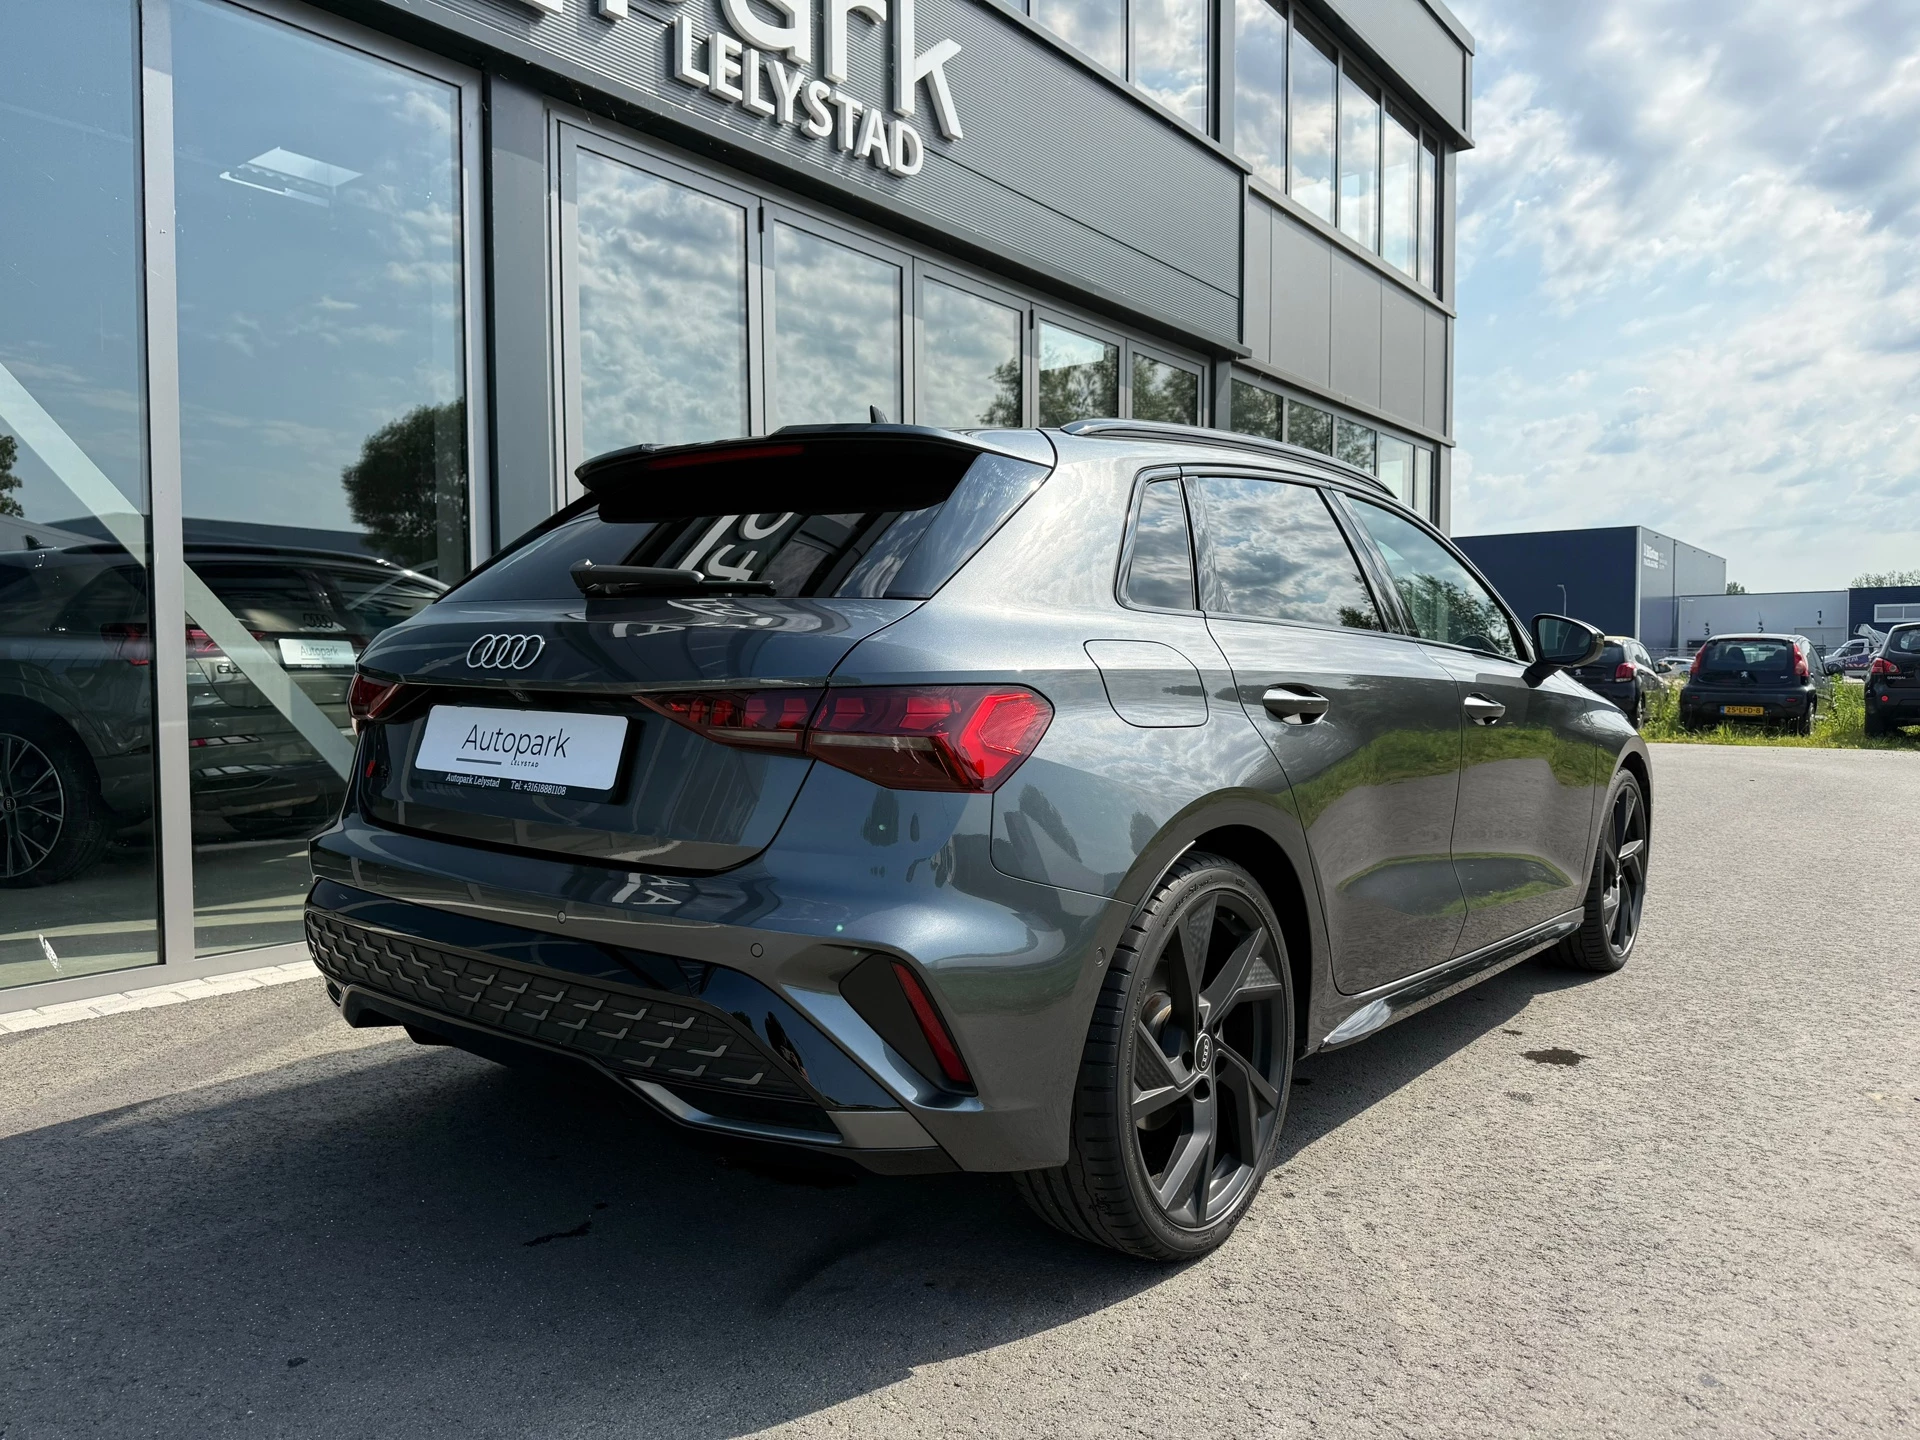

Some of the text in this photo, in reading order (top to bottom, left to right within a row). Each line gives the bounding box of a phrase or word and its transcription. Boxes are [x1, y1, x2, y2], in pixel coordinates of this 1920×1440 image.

[673, 15, 924, 176] LELYSTAD
[1817, 610, 1822, 619] 1
[1704, 627, 1711, 636] 3
[301, 645, 340, 657] Autopark
[461, 724, 571, 760] Autopark
[510, 759, 540, 768] LELYSTAD
[445, 773, 474, 785] Autopark
[473, 775, 501, 788] Lelystad
